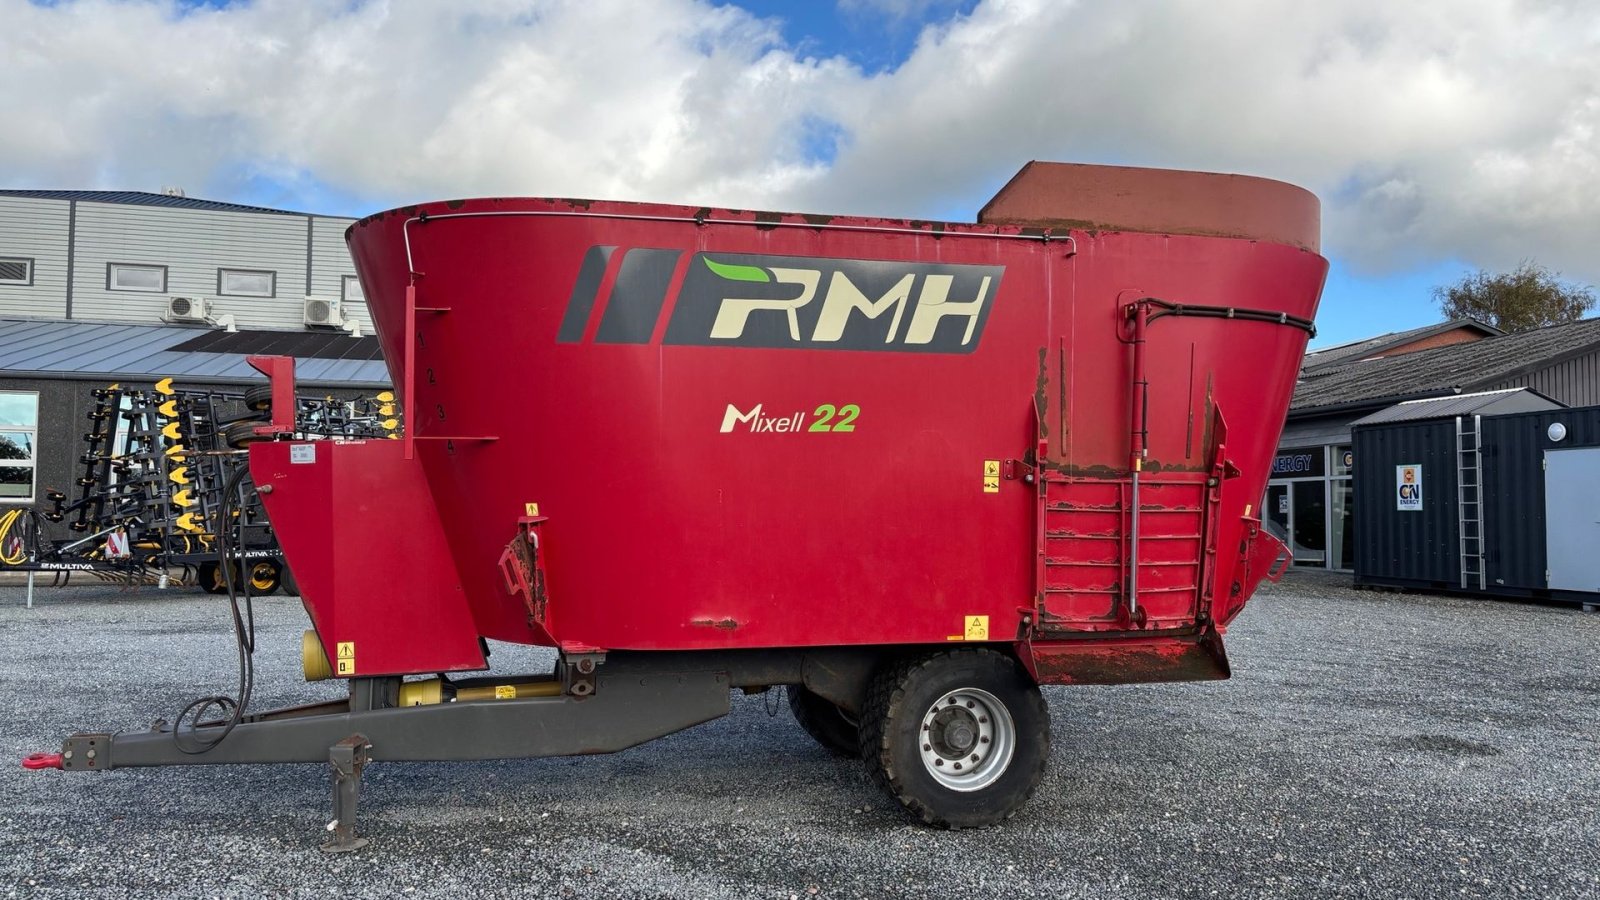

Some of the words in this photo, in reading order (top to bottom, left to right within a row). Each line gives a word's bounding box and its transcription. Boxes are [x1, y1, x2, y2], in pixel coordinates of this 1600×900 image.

[703, 256, 992, 346] RMH
[427, 368, 435, 384] 2
[437, 404, 445, 420] 3
[719, 403, 806, 433] Mixell
[808, 404, 861, 433] 22
[1399, 484, 1420, 500] CN
